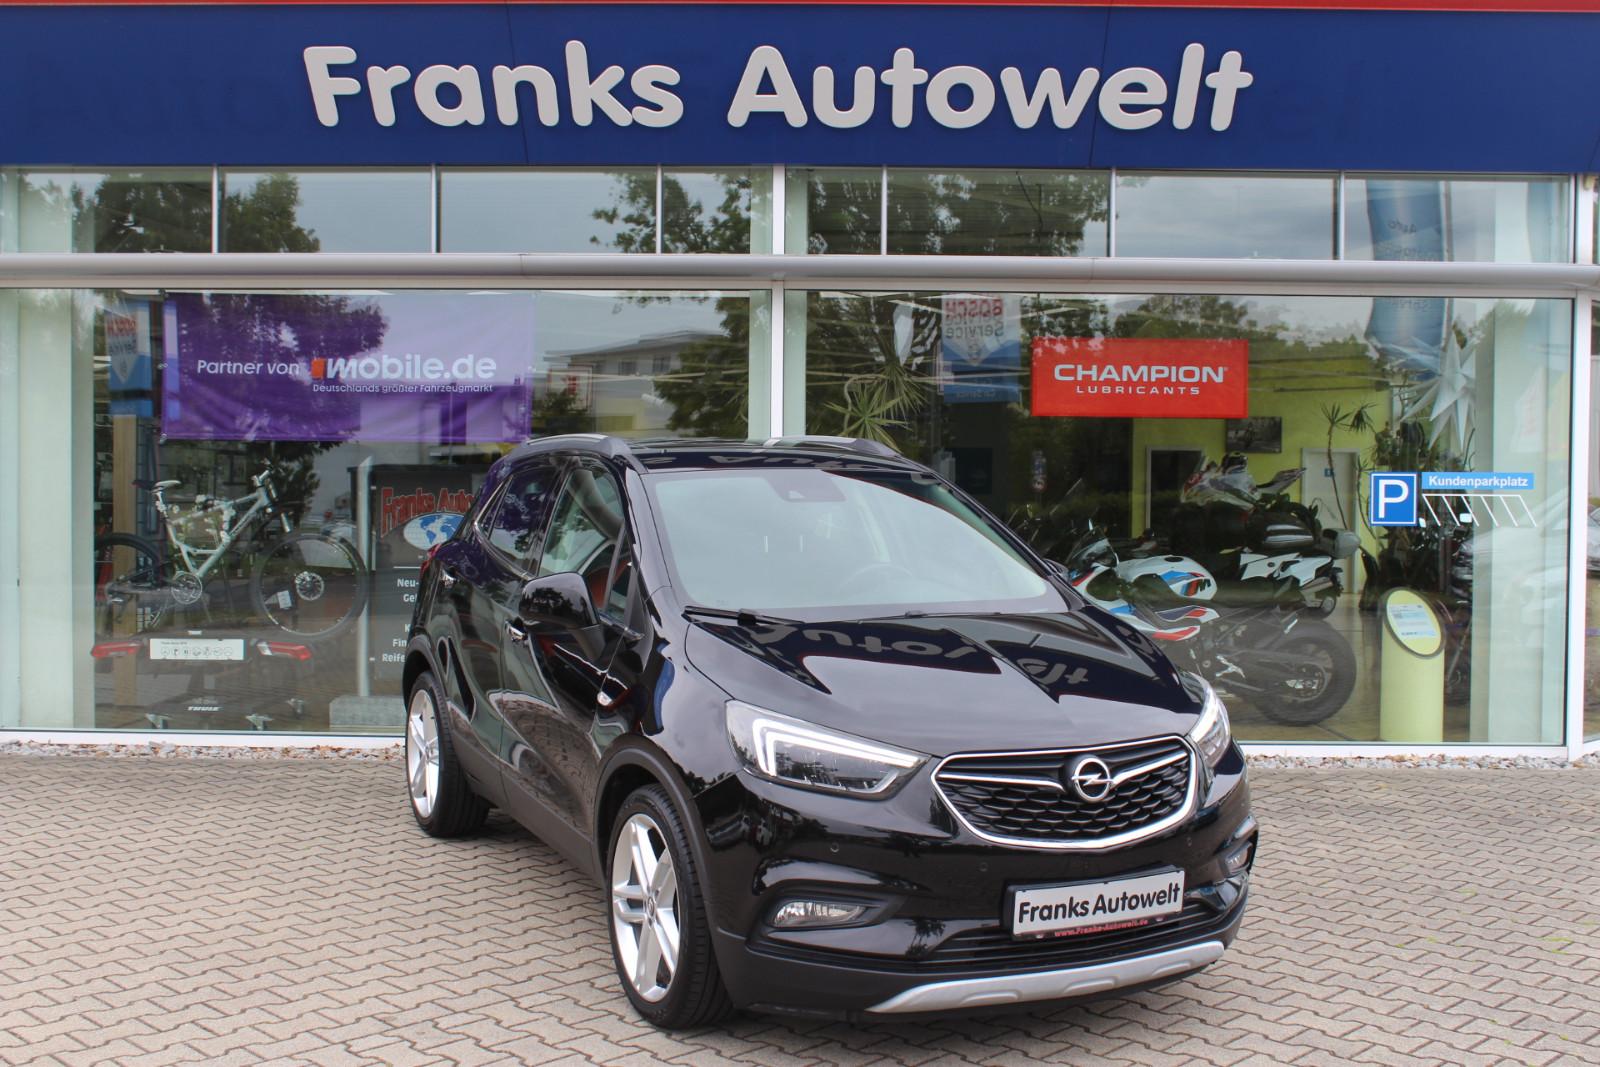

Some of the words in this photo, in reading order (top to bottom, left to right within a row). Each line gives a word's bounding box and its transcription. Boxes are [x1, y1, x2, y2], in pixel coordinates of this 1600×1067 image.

[303, 40, 684, 128] Franks
[727, 42, 1254, 132] Autowelt
[197, 360, 262, 375] Partner
[267, 363, 300, 375] von
[326, 354, 497, 379] mobile.de
[1054, 364, 1224, 383] CHAMPION
[312, 384, 380, 393] Deutschlands
[420, 384, 493, 394] Fahrzeugmarkt
[1076, 386, 1200, 395] LUBRICANTS
[1428, 476, 1529, 489] Kundenparkplatz
[381, 487, 436, 538] Franks
[397, 578, 419, 587] Neu-
[1018, 896, 1090, 924] Franks
[1092, 882, 1181, 916] Autowelt
